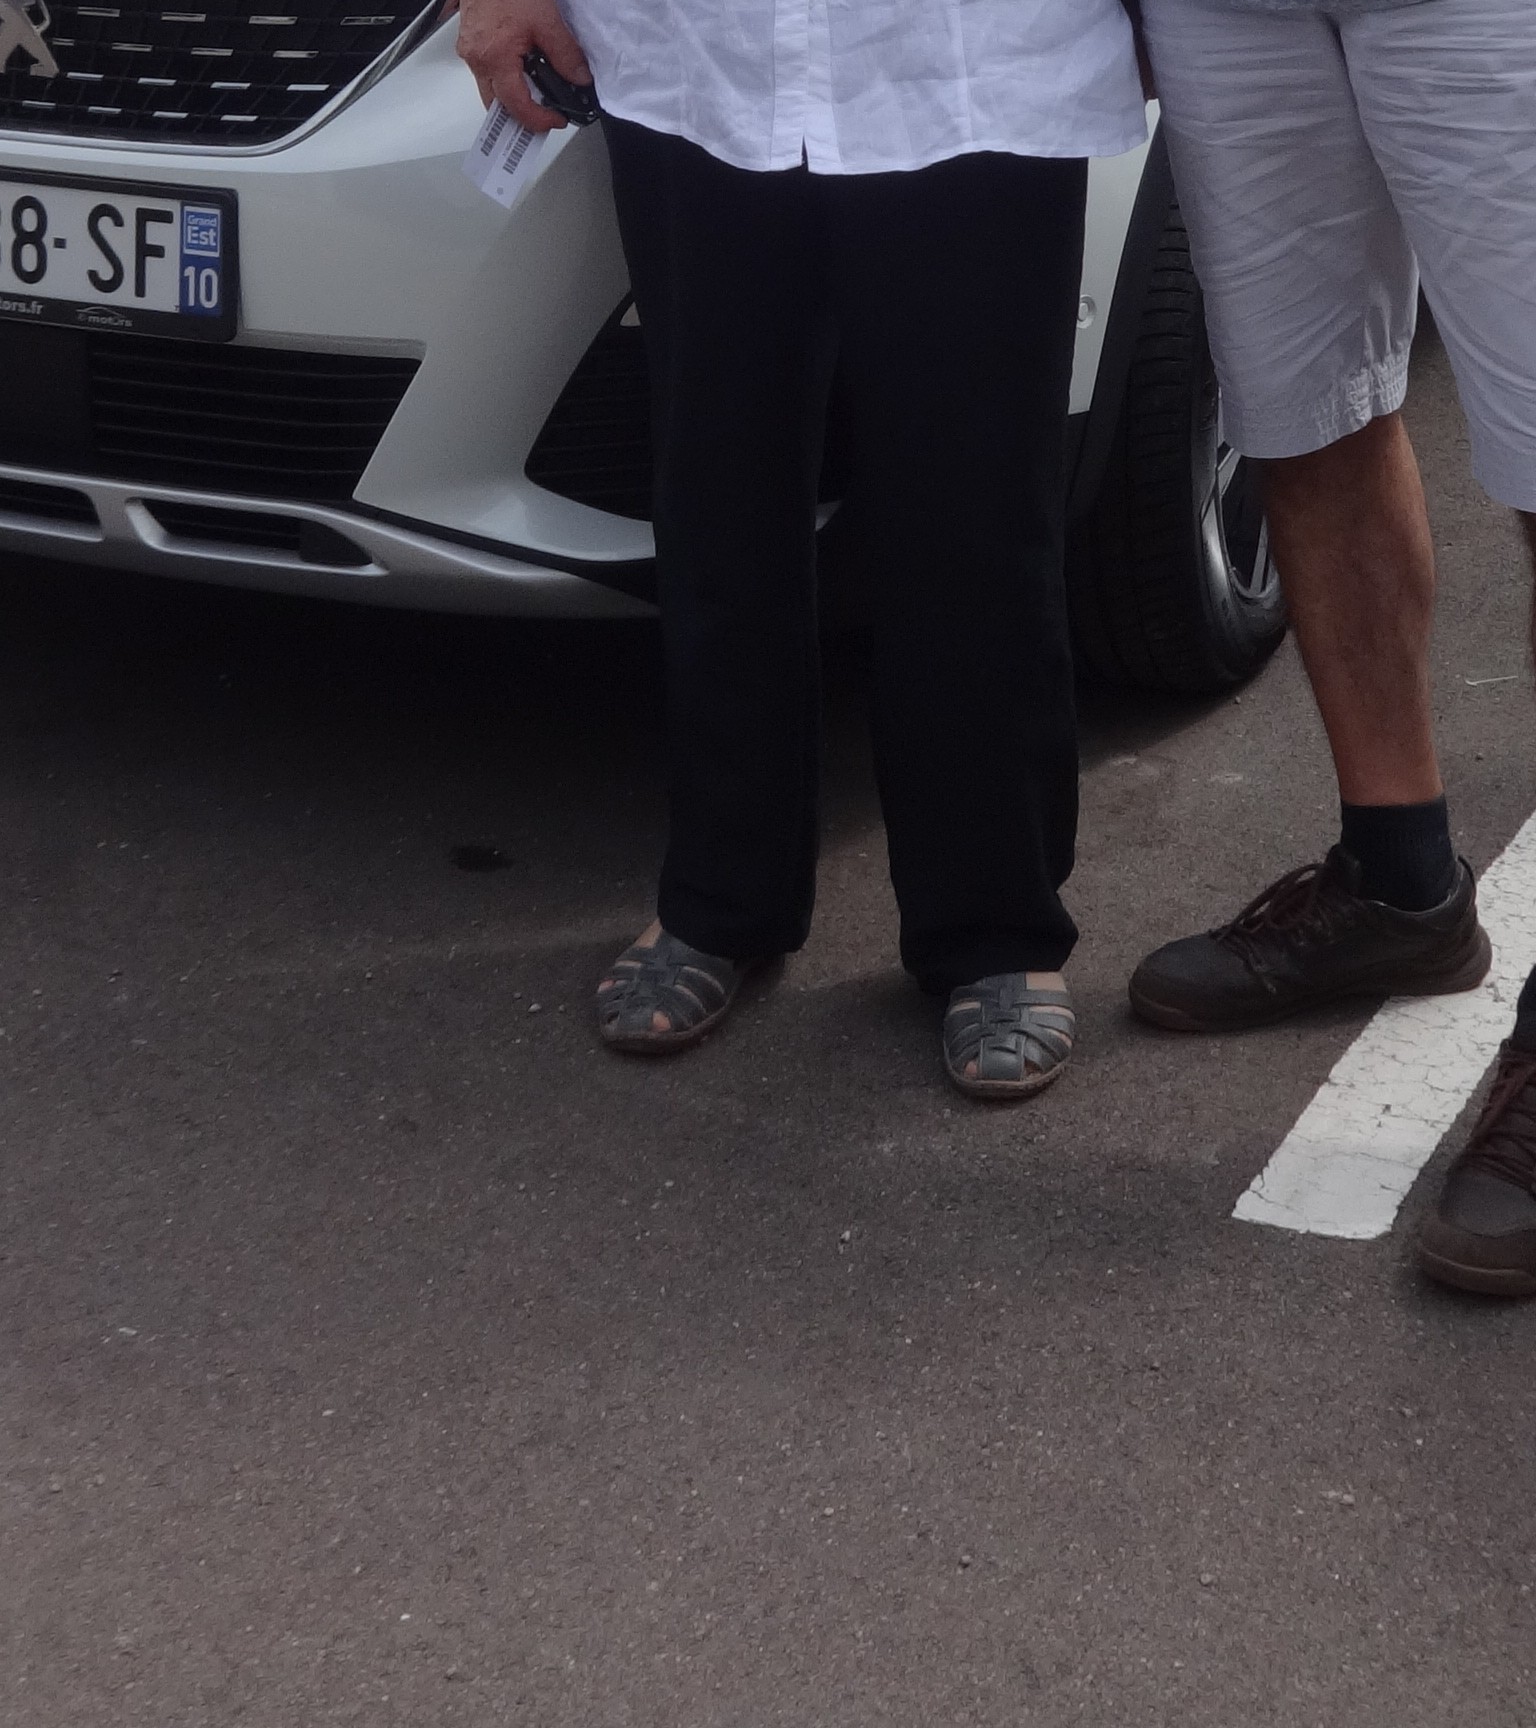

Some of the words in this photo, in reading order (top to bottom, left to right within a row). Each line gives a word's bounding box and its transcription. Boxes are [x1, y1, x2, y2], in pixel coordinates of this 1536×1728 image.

[186, 213, 218, 227] Grand
[186, 225, 217, 247] Est
[183, 265, 220, 309] 10
